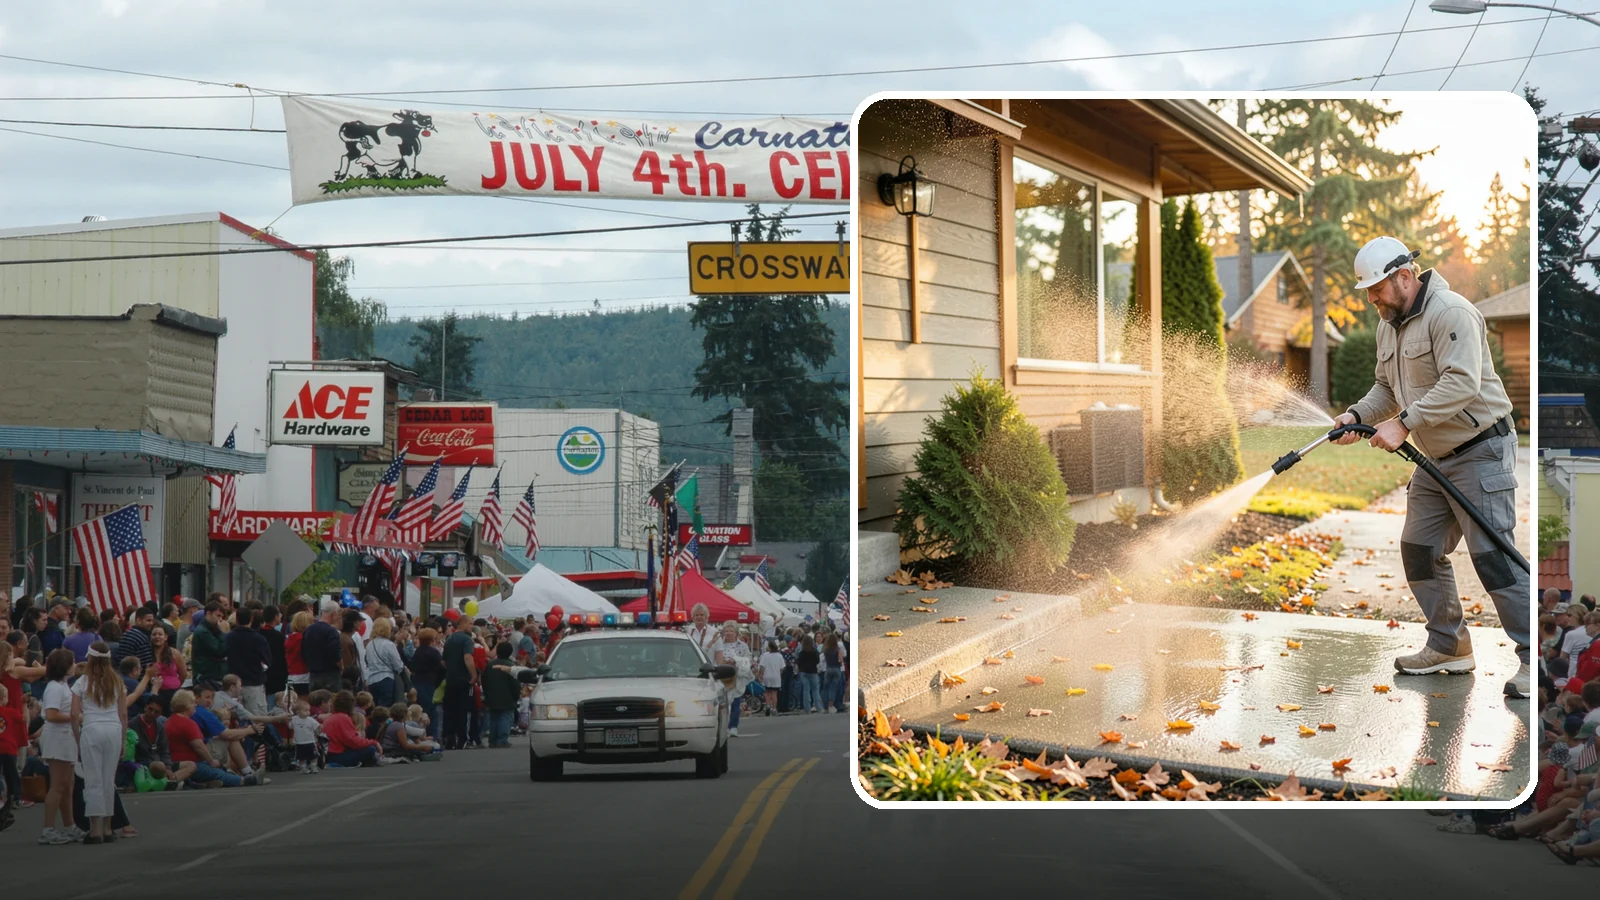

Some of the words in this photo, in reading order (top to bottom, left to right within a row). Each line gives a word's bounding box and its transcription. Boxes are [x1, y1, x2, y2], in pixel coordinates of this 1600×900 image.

[481, 141, 606, 193] JULY
[632, 149, 746, 197] 4th.
[697, 254, 850, 280] CROSSWA
[283, 380, 373, 420] ACE
[405, 409, 452, 421] CEDAR
[461, 409, 485, 421] LOG
[283, 420, 371, 437] Hardware
[416, 427, 477, 447] Coca-Cola
[83, 485, 92, 494] St.
[95, 485, 124, 495] Vincent
[126, 486, 136, 495] de
[137, 486, 155, 495] Paul
[688, 526, 741, 535] CRNATION
[699, 535, 730, 543] GLASS
